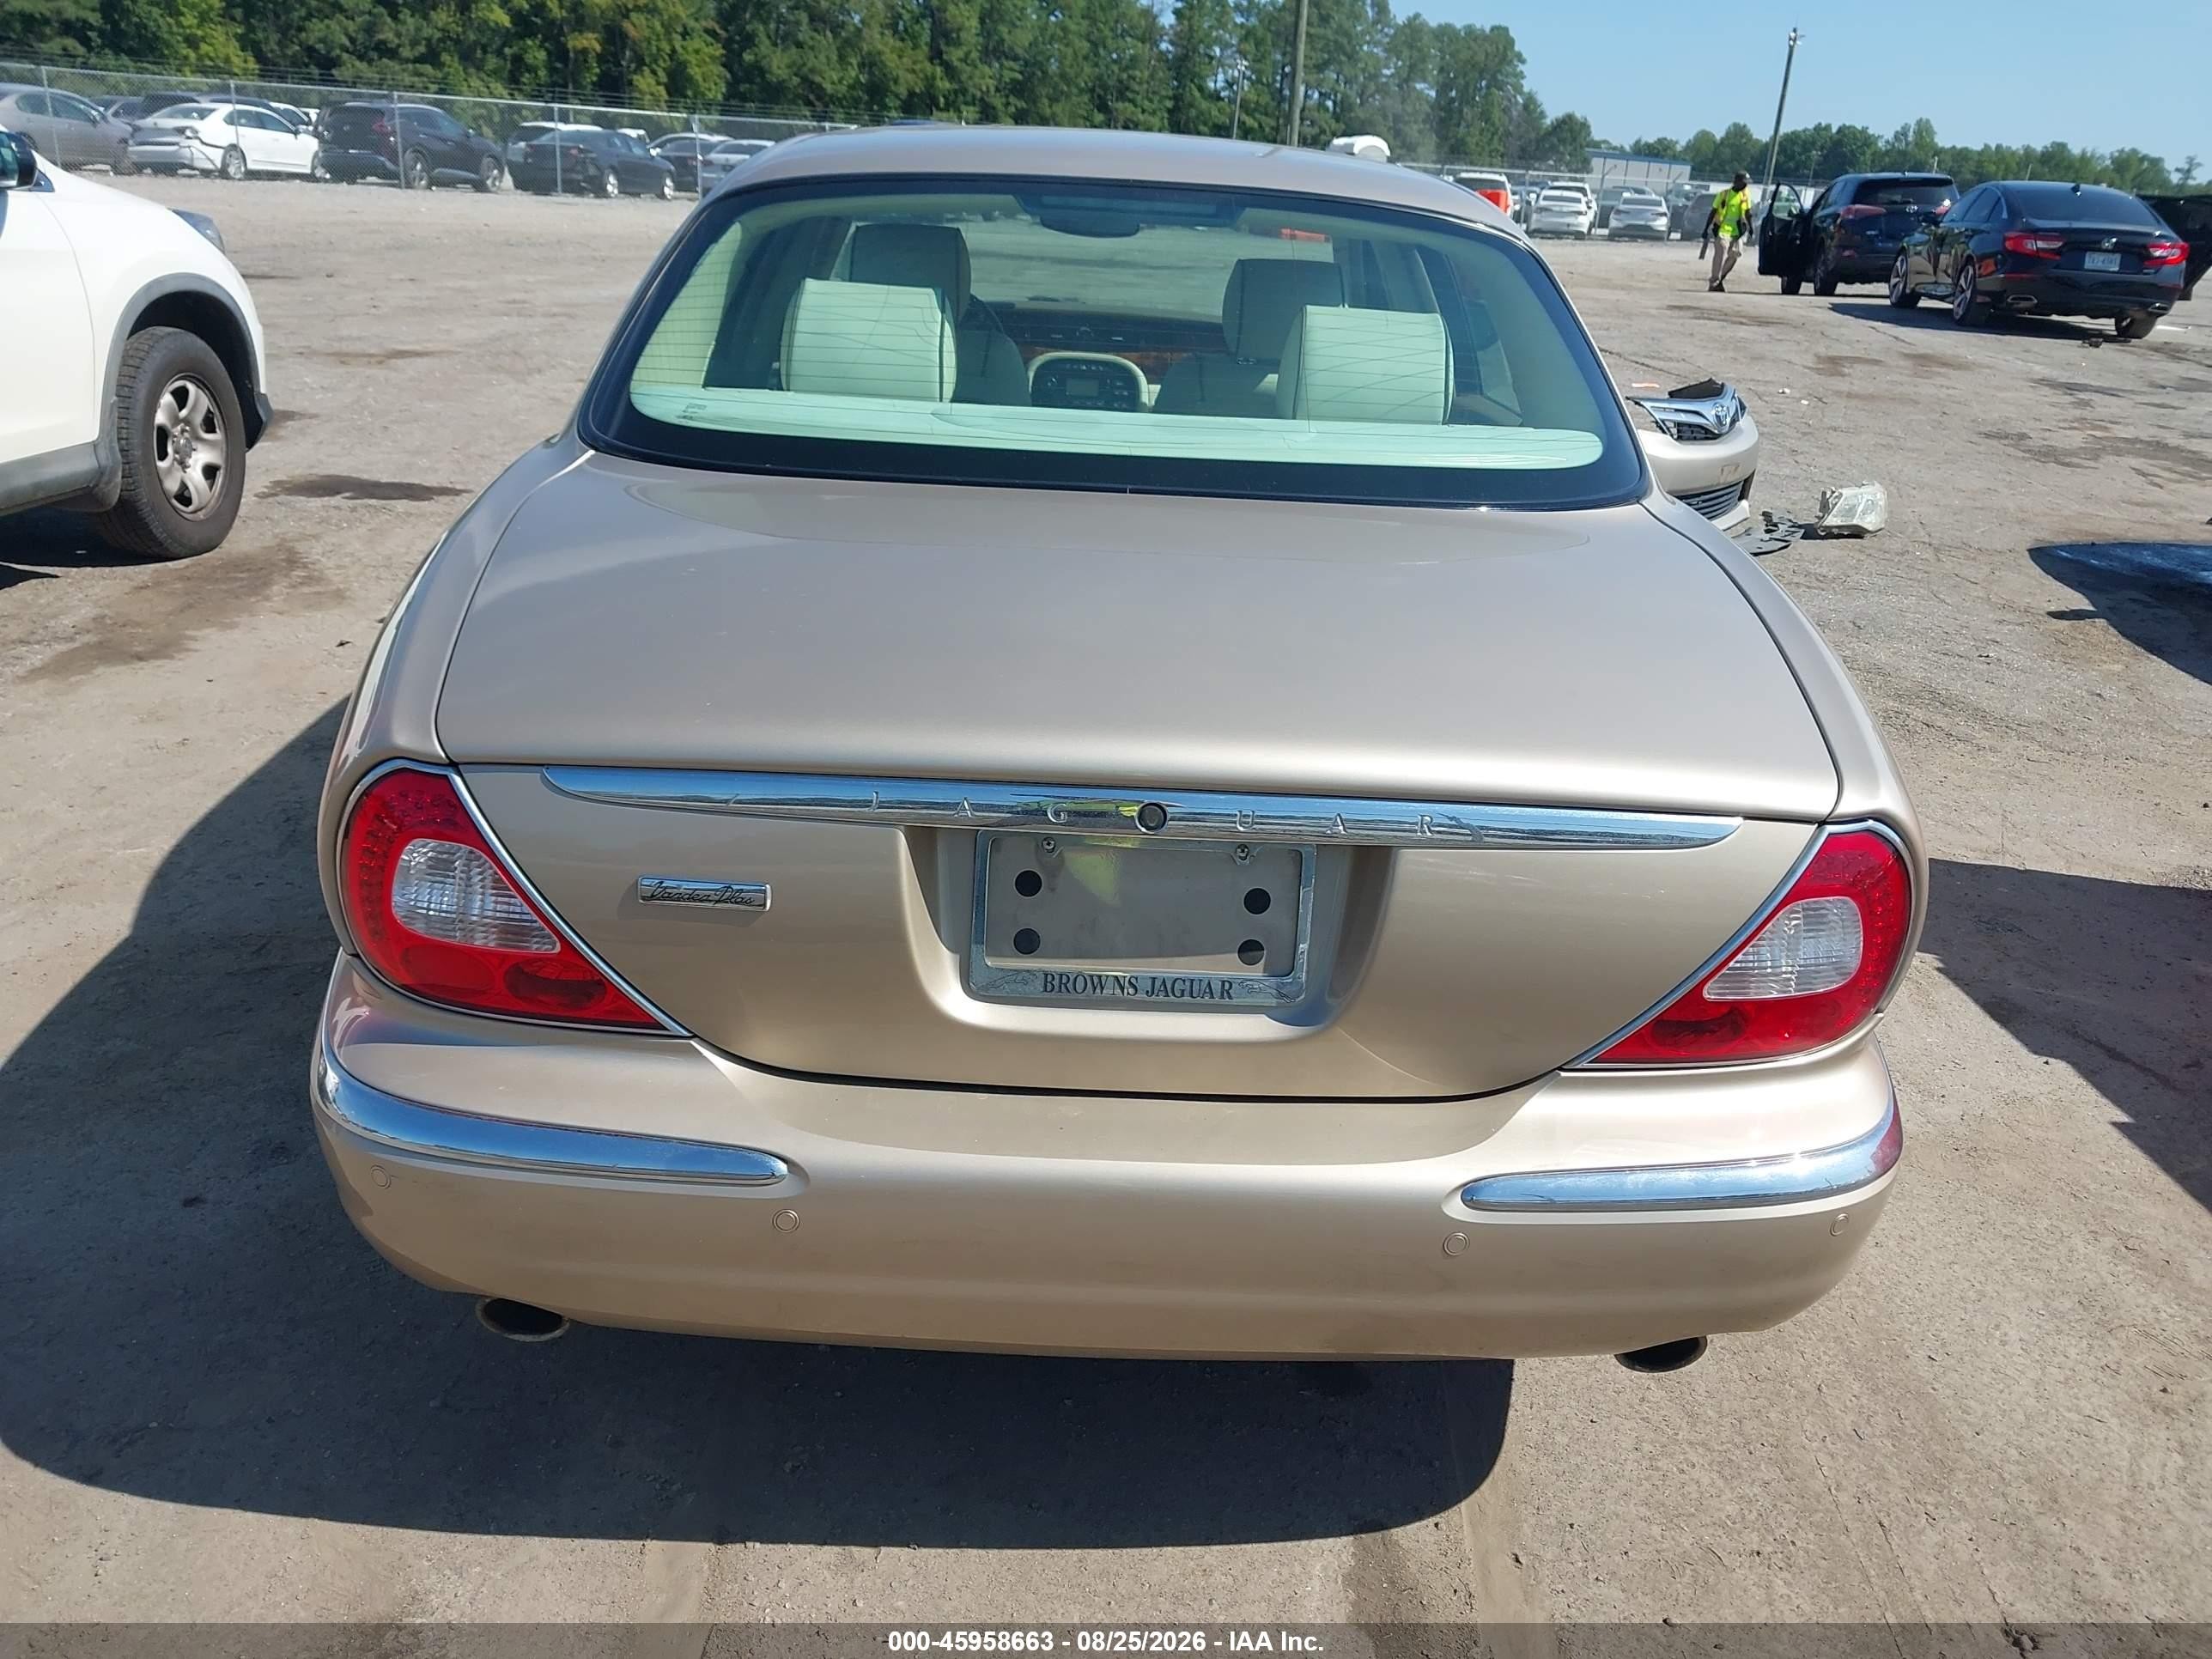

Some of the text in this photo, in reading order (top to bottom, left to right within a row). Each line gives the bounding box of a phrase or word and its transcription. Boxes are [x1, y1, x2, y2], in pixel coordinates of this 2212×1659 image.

[867, 789, 1435, 838] JAGUAR
[1042, 972, 1234, 1000] BROWNS JAGUAR
